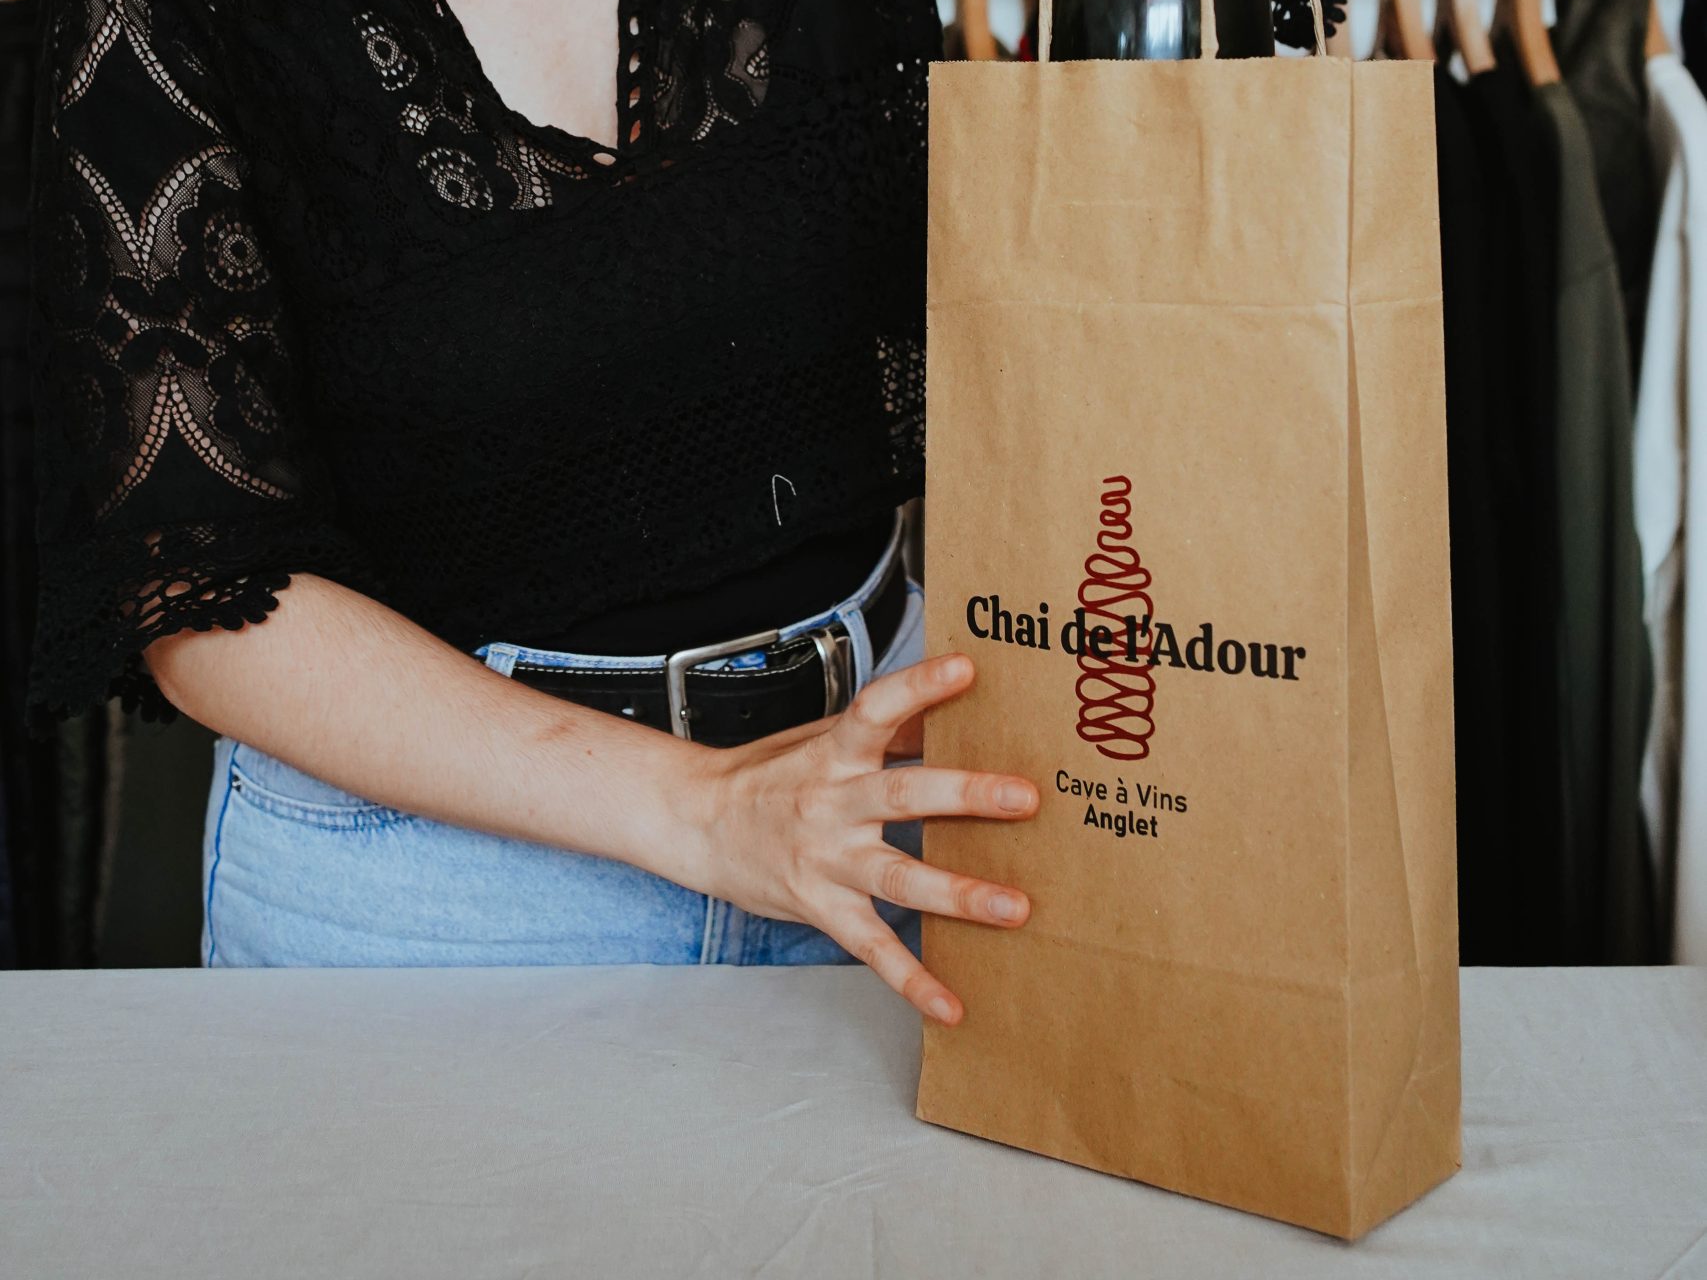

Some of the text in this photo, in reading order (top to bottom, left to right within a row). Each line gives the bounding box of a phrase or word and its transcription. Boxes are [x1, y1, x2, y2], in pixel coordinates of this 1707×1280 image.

[966, 595, 1306, 680] Chai de l'Adour
[1056, 770, 1188, 813] Cave à Vins
[1084, 804, 1158, 838] Anglet
